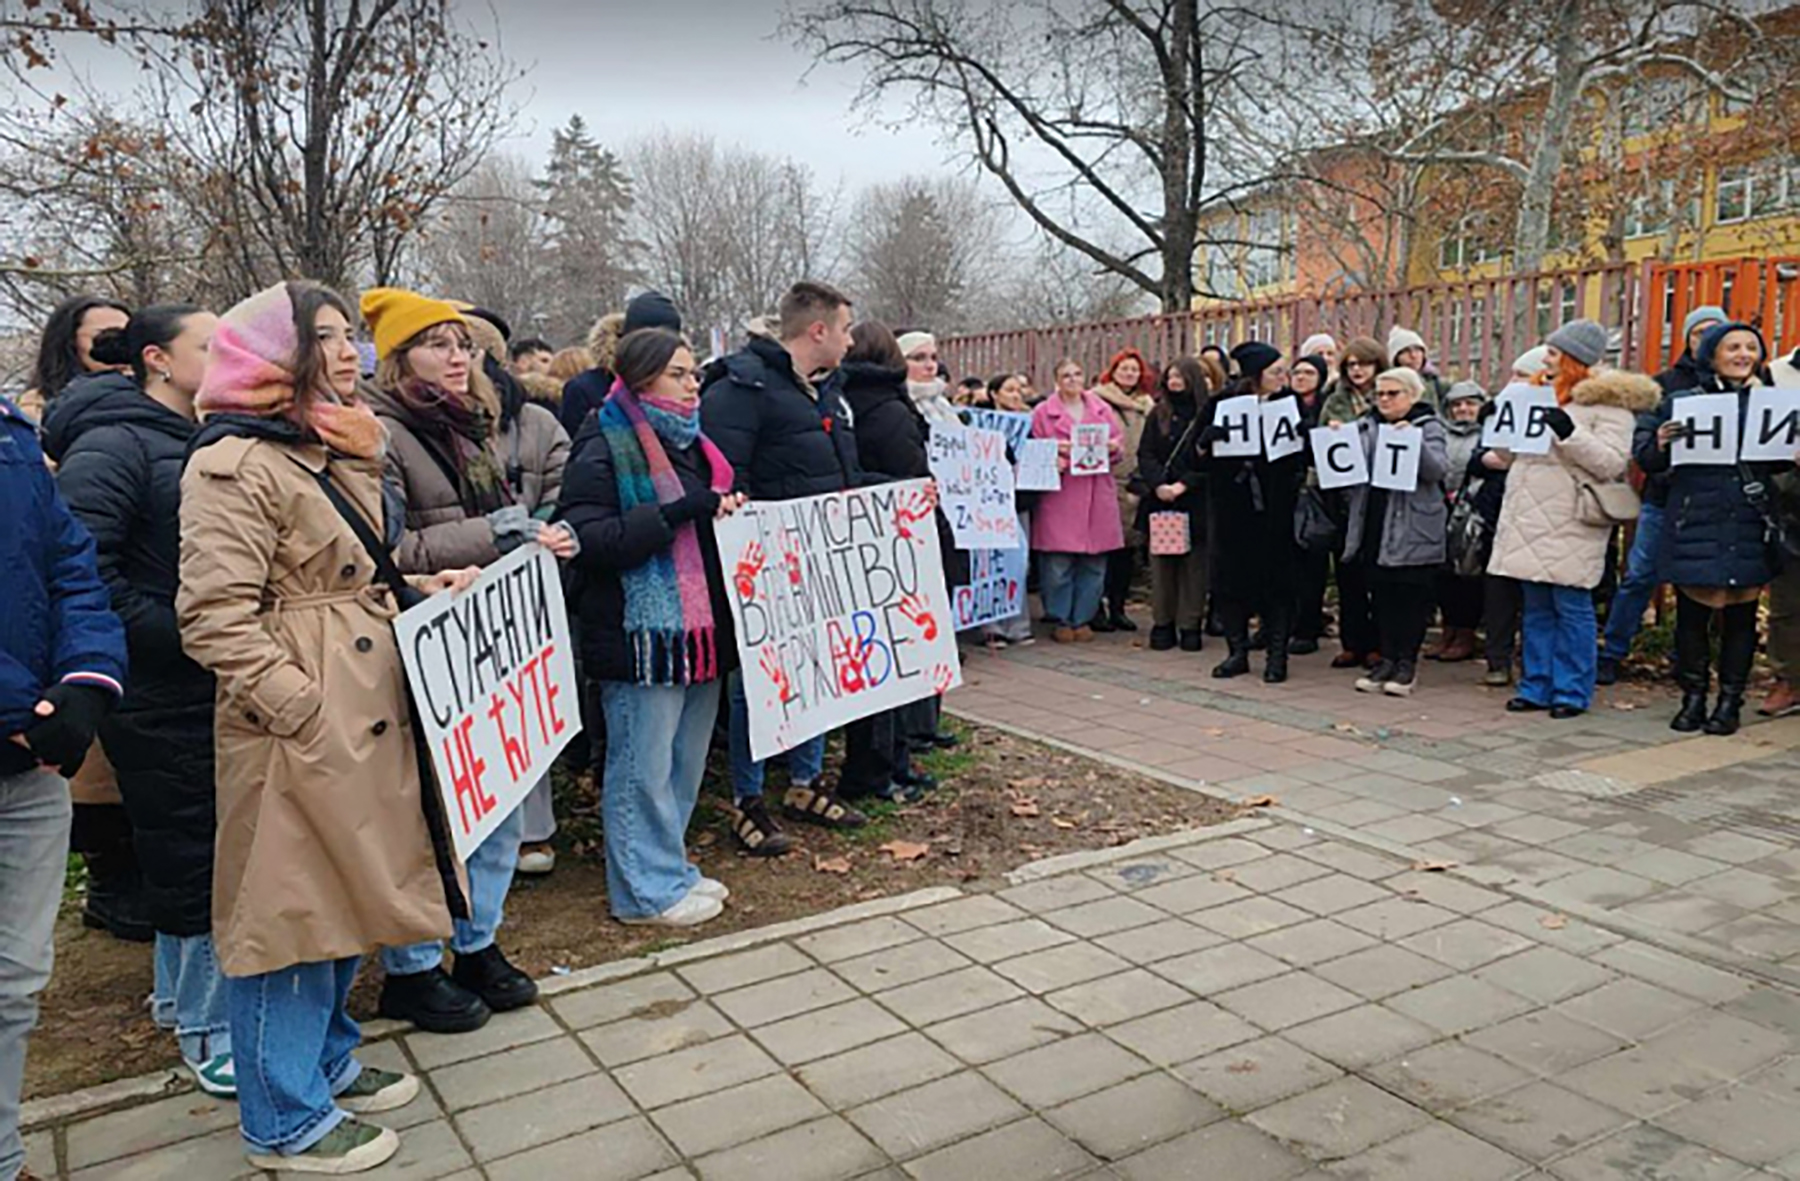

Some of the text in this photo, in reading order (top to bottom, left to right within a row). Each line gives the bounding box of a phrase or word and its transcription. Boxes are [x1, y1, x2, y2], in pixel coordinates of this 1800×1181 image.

[1222, 413, 1249, 443] Н
[1271, 416, 1295, 446] А
[1494, 401, 1515, 433] А
[1525, 405, 1546, 438] В
[1686, 415, 1722, 449] Н
[1758, 408, 1798, 445] И
[1327, 442, 1354, 472] С
[1386, 443, 1408, 475] Т
[778, 489, 900, 553] НИСАМ
[414, 554, 553, 729] СТУДЕНТИ
[443, 645, 566, 834] НЕ ЋУТЕ
